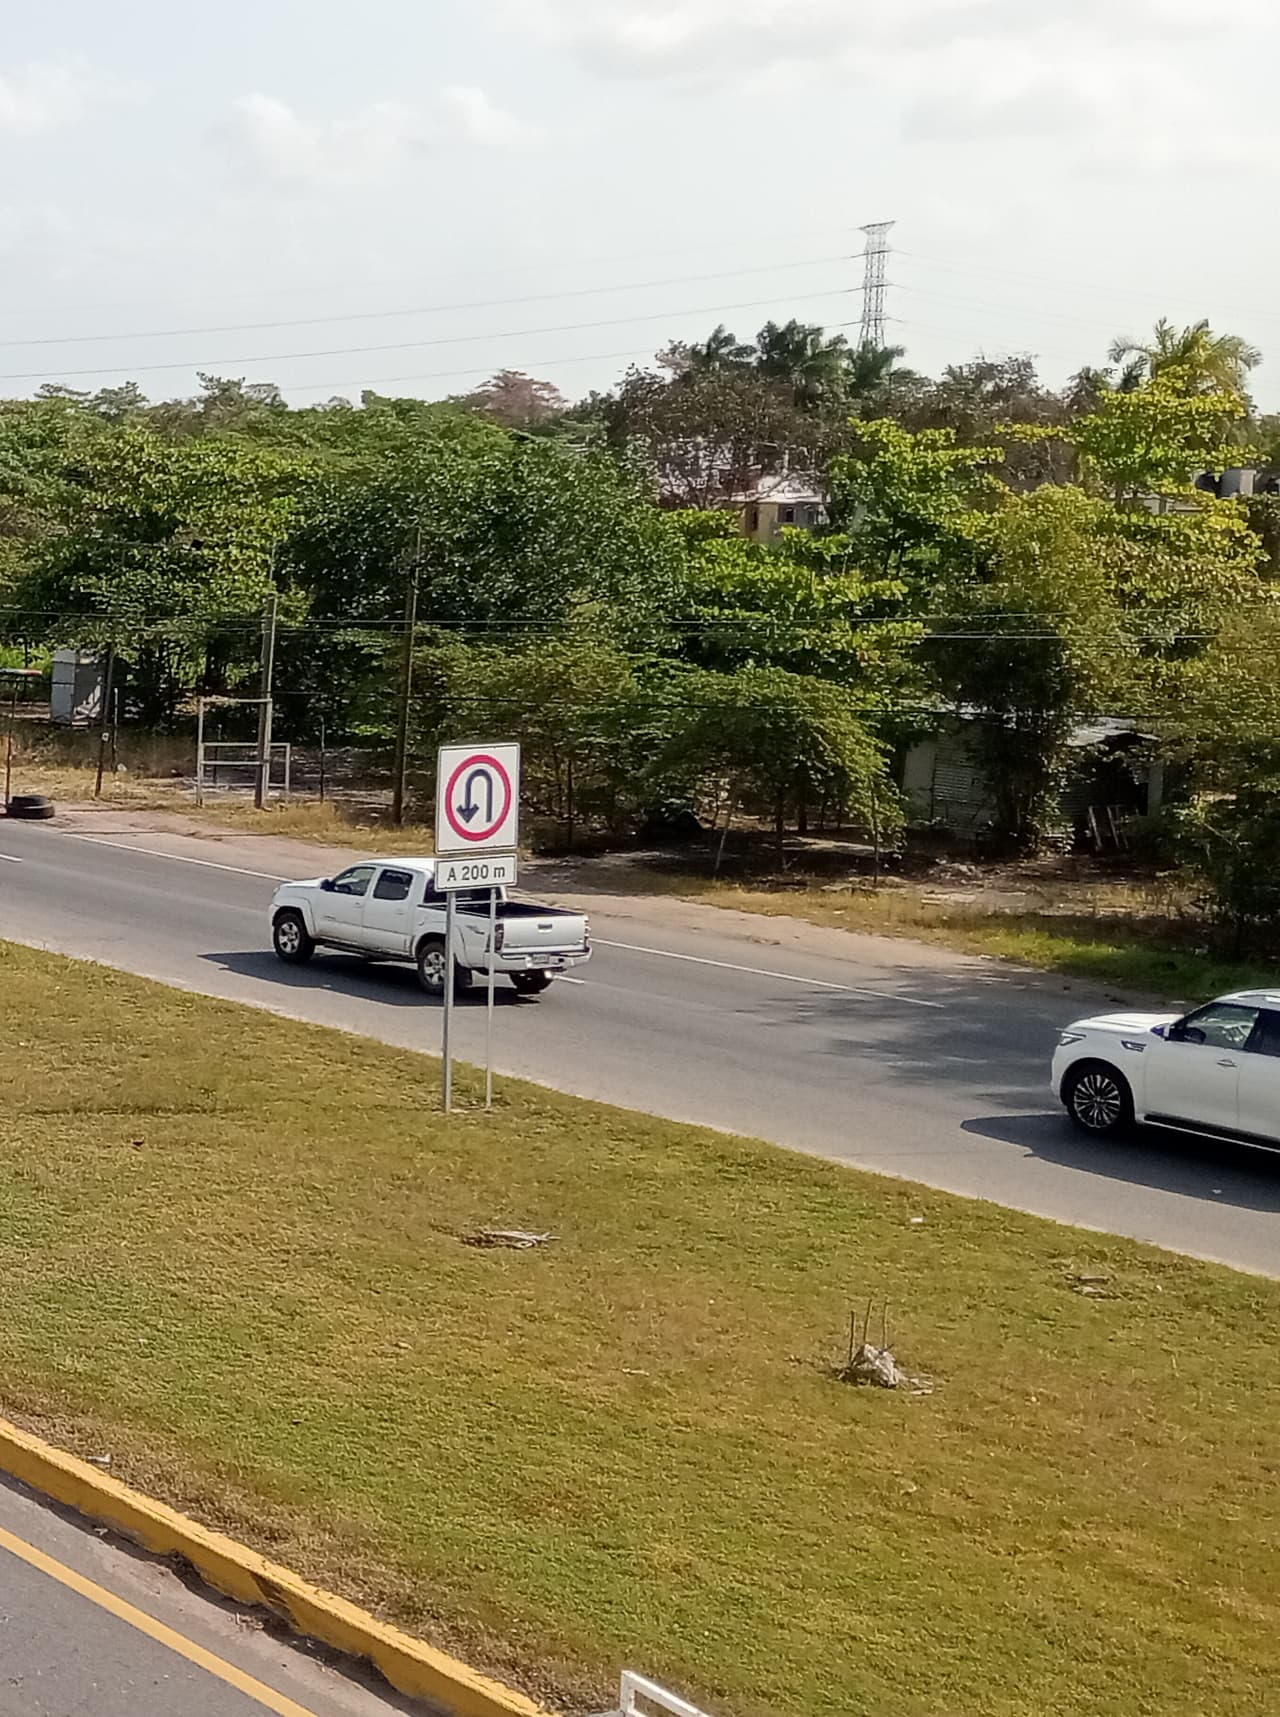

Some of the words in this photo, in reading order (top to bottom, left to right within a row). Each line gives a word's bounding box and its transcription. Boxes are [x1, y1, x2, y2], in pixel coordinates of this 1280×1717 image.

[447, 866, 457, 881] A
[461, 864, 489, 881] 200
[493, 866, 506, 878] m
